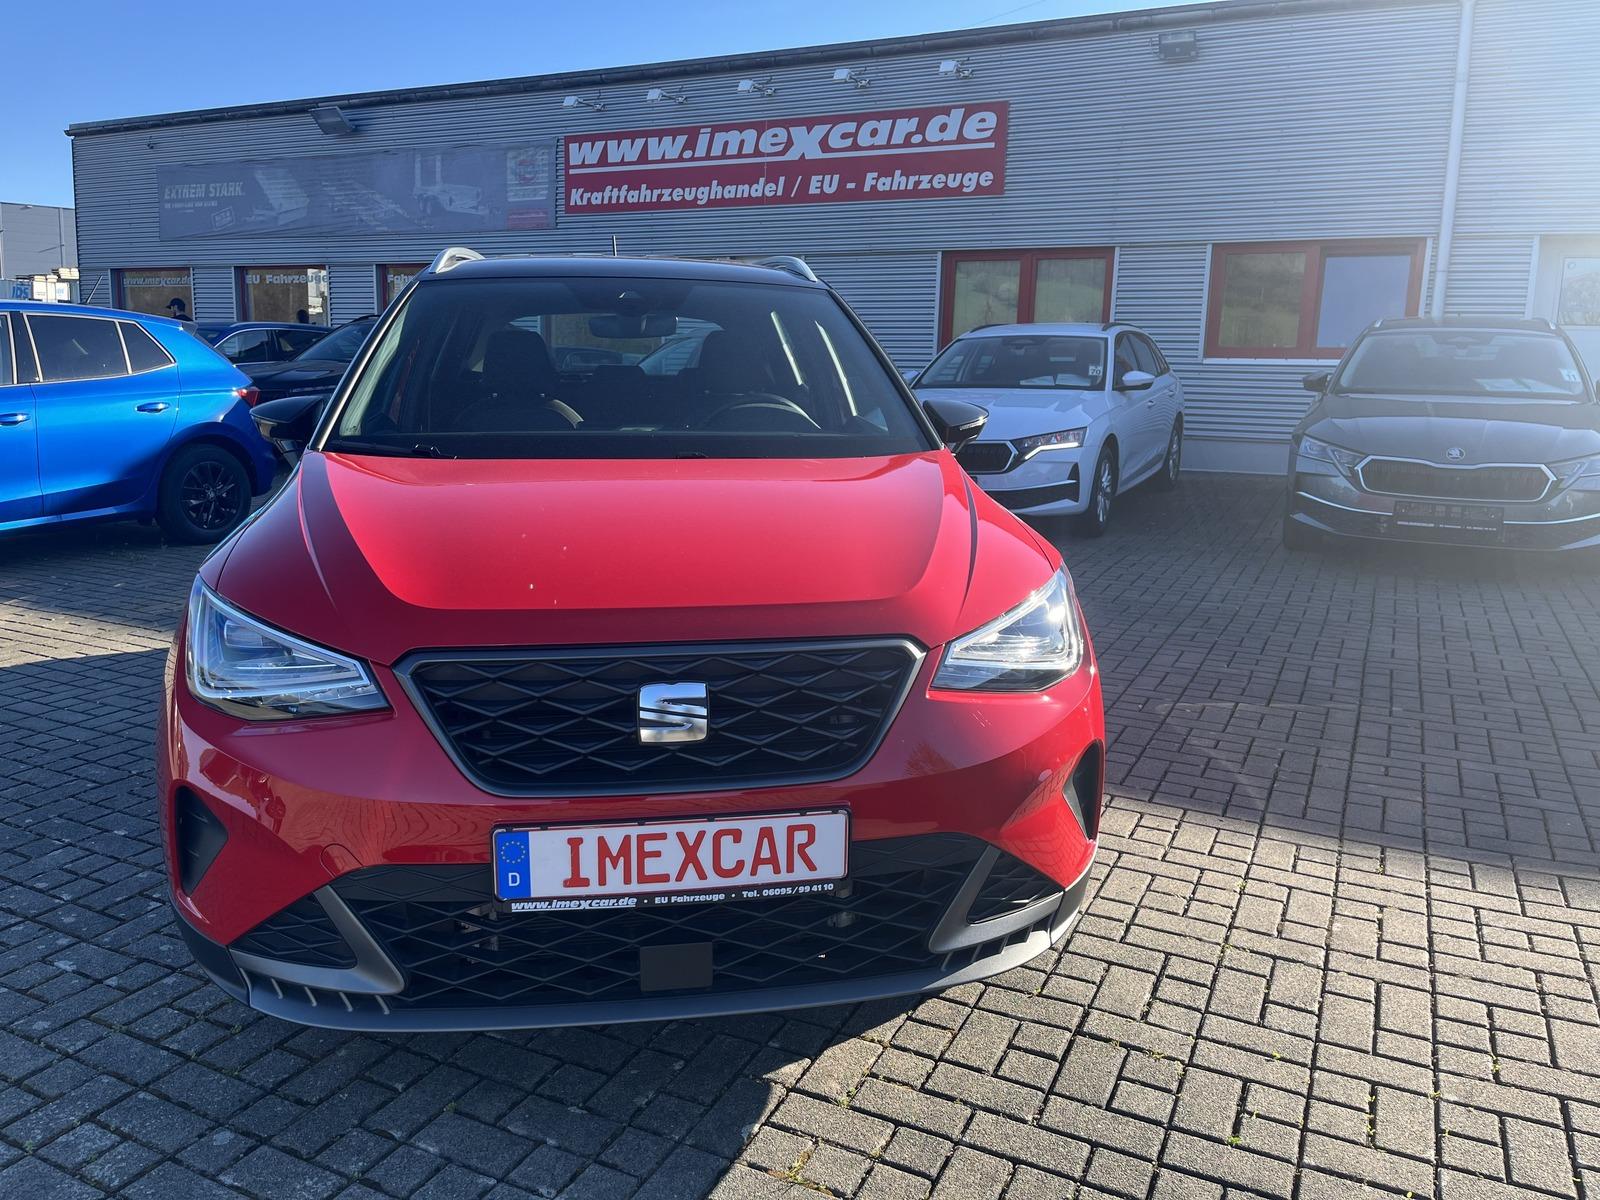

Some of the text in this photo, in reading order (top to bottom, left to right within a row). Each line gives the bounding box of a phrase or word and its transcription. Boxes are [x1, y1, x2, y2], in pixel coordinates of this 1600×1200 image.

[568, 107, 998, 166] www.imexcar.de
[165, 183, 205, 198] EXTREM
[569, 176, 785, 206] Kraftfahrzeughandel
[790, 176, 802, 199] /
[808, 174, 840, 195] EU
[864, 168, 994, 193] Fahrzeuge
[245, 273, 329, 284] EU Fahrzeuge
[563, 823, 818, 888] IMEXCAR
[508, 872, 520, 887] D
[511, 896, 637, 911] www.imexcar.de
[654, 896, 668, 905] EU
[670, 892, 725, 904] Fahrzeuge
[742, 890, 760, 899] Tel.
